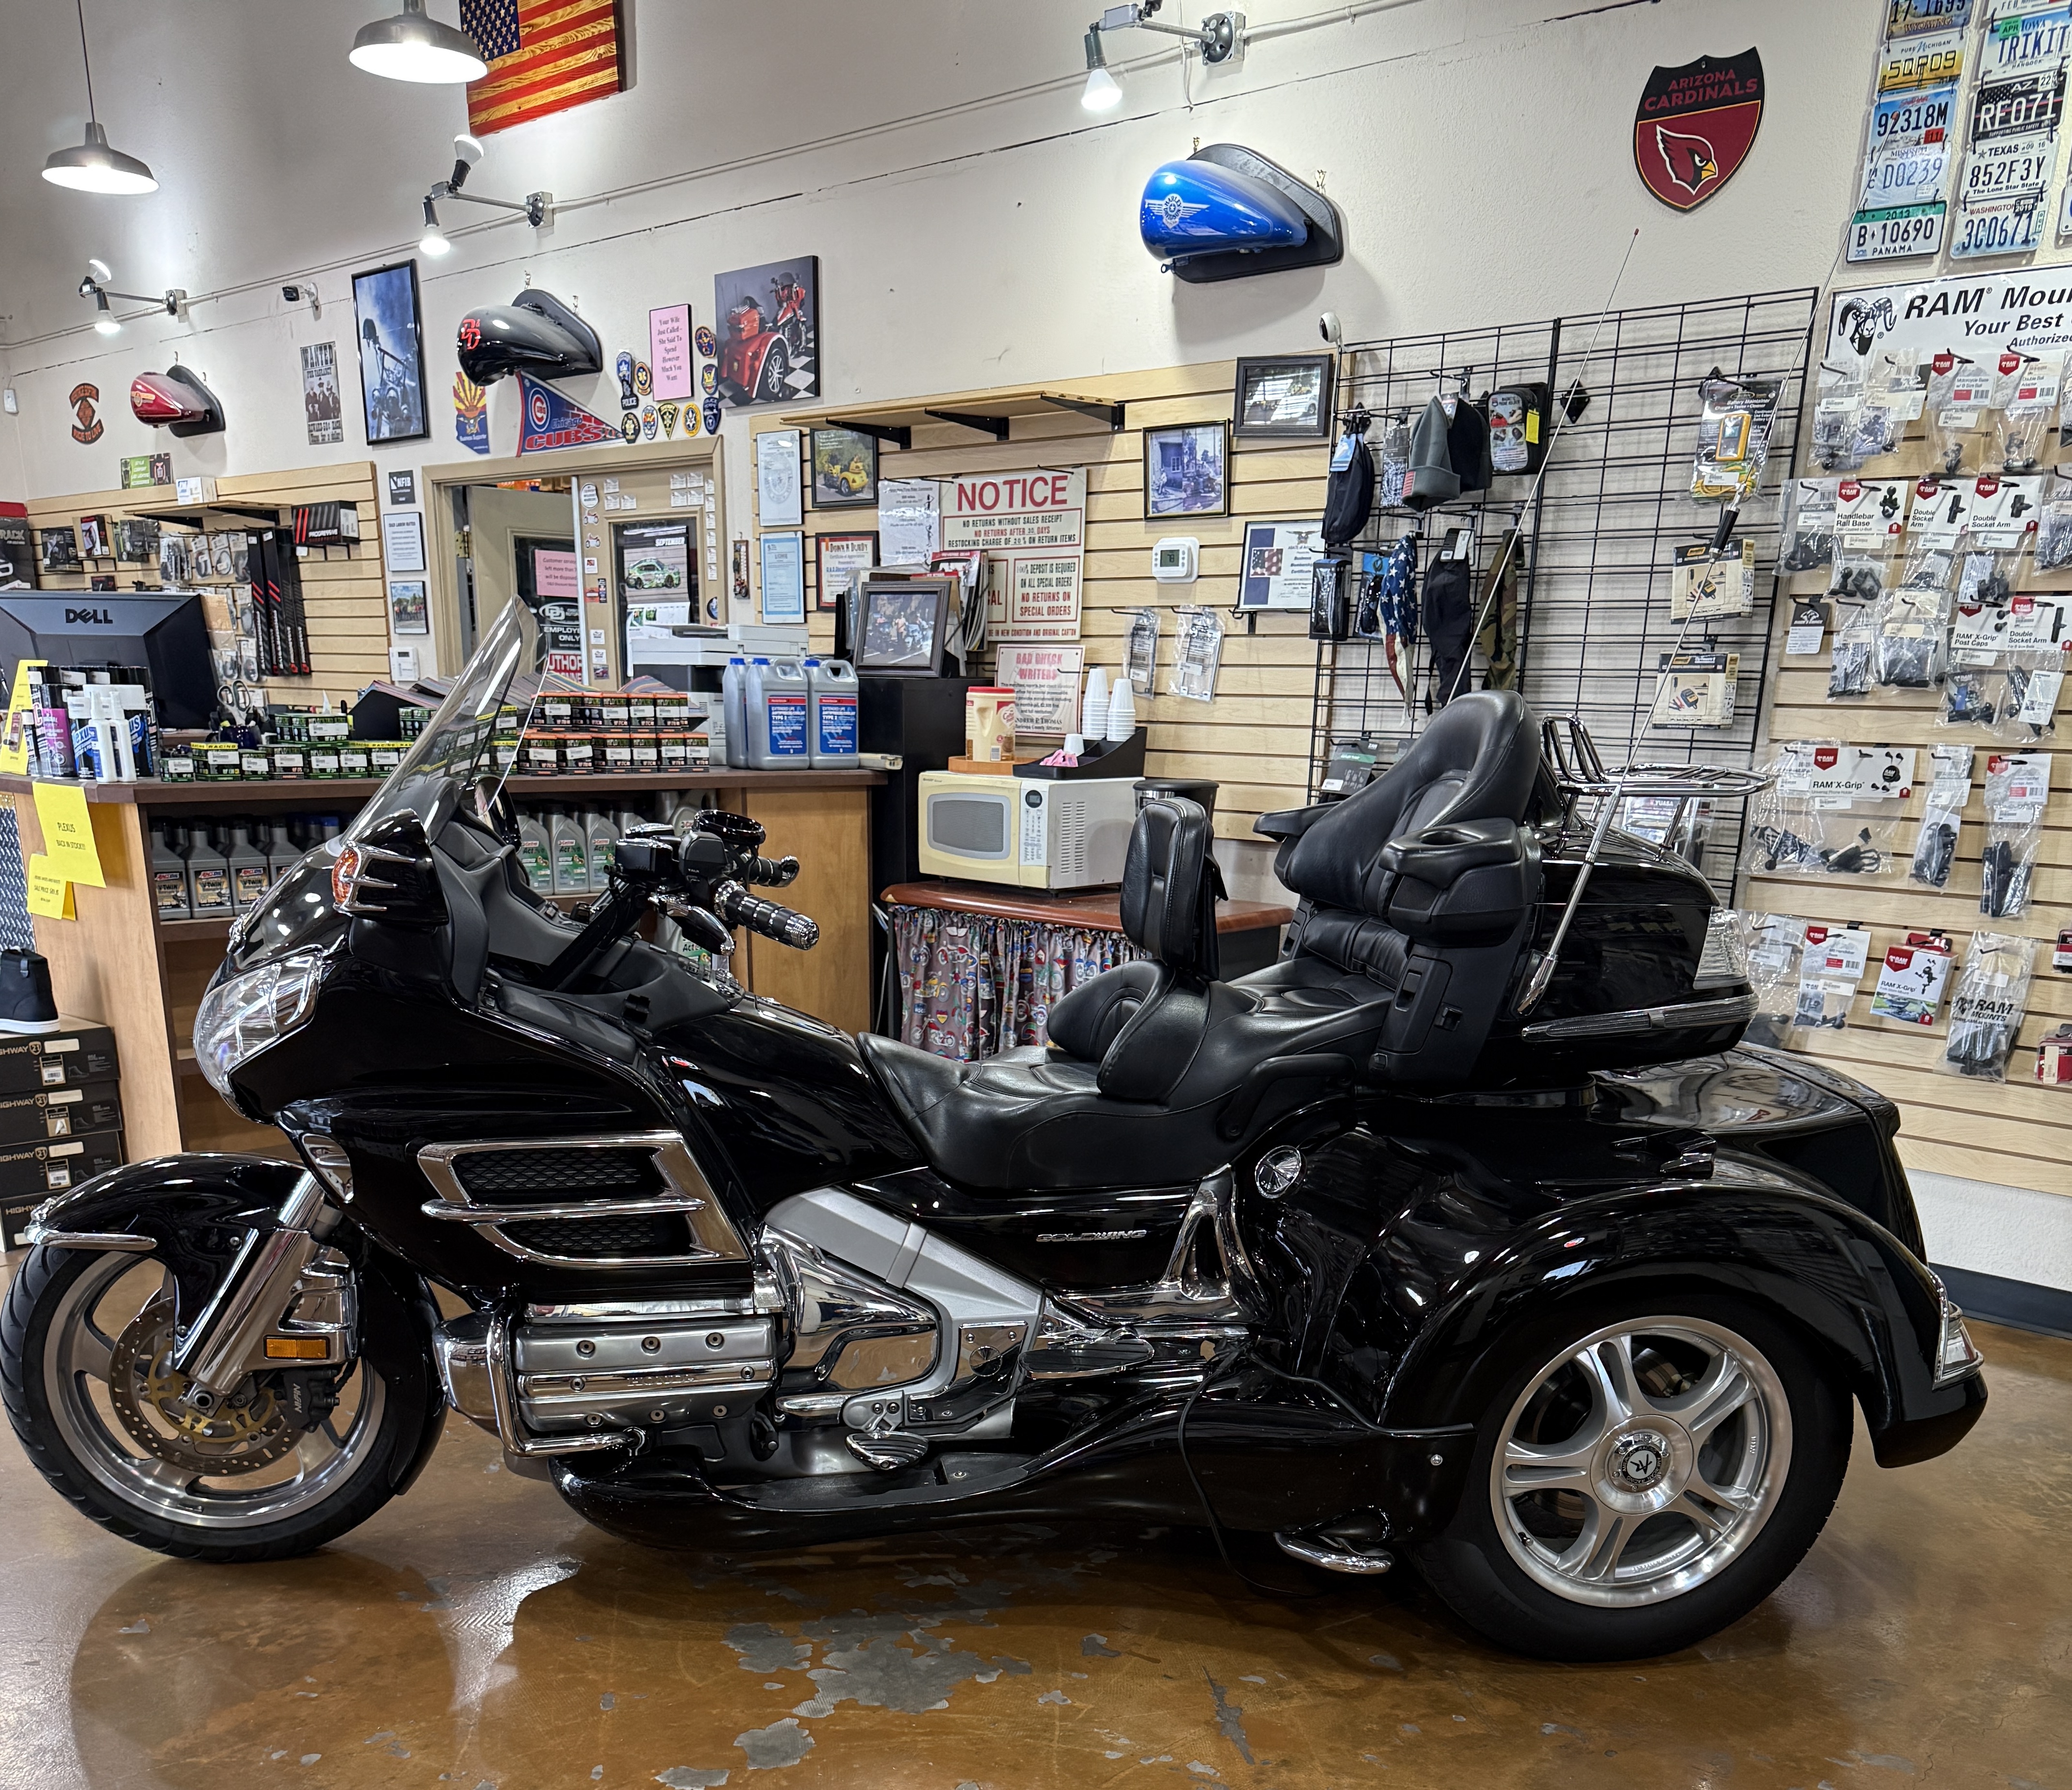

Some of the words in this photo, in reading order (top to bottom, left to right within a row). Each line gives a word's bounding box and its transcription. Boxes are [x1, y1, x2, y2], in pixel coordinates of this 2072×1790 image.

[1904, 16, 1953, 33] WYOMING
[2003, 24, 2019, 34] APR
[2021, 18, 2045, 32] IOWA
[1915, 39, 1952, 54] MICHIGAN
[1668, 69, 1736, 91] ARIZONA
[2010, 80, 2033, 94] AZ
[2040, 75, 2051, 87] 22
[1644, 78, 1758, 111] CARDINALS
[1877, 101, 1949, 137] 92318M
[1929, 132, 1940, 142] 11
[1988, 144, 2019, 157] TEXAS
[1970, 156, 2046, 188] 852F3Y
[1886, 210, 1910, 221] 2013
[1881, 218, 1935, 245] 10690
[1872, 243, 1913, 256] PANAMA
[1964, 318, 2010, 337] Your
[2016, 312, 2064, 331] Best
[302, 344, 333, 369] WANTED
[665, 345, 677, 355] Spend
[621, 397, 636, 407] POLICE
[550, 417, 583, 429] Chicago
[524, 426, 606, 450] CUBS
[397, 476, 411, 488] NFIB
[957, 475, 1068, 512] NOTICE
[972, 519, 995, 527] RETURNS
[997, 517, 1021, 526] WITHOUT
[1023, 516, 1039, 524] SALES
[1041, 514, 1062, 523] RECEIPT
[983, 528, 1007, 537] RETURNS
[1009, 527, 1026, 536] AFTER
[1037, 526, 1050, 534] DAYS
[948, 539, 979, 548] RESTOCKING
[981, 538, 1002, 546] CHARGE
[1038, 535, 1058, 544] RETURN
[1060, 534, 1076, 543] ITEMS
[1030, 563, 1048, 574] DEPOSIT
[1055, 562, 1076, 574] REQUIRED
[1037, 577, 1054, 588] SPECIAL
[1056, 576, 1072, 587] ORDERS
[1021, 592, 1030, 602] NO
[1032, 591, 1060, 602] RETURNS
[1062, 591, 1071, 602] ON
[65, 608, 114, 624] DELL
[1020, 606, 1044, 617] SPECIAL
[1047, 605, 1071, 616] ORDERS
[1016, 652, 1033, 665] BAD
[1035, 652, 1063, 665] CHECK
[1019, 668, 1058, 680] WRITERS
[57, 822, 76, 833] PLEXUS
[1974, 998, 2014, 1015] RAM
[1971, 1010, 2007, 1022] MOUNTS
[30, 1044, 40, 1052] 21
[36, 1096, 47, 1105] 21
[36, 1149, 47, 1157] 21
[627, 1373, 696, 1387] HONDA
